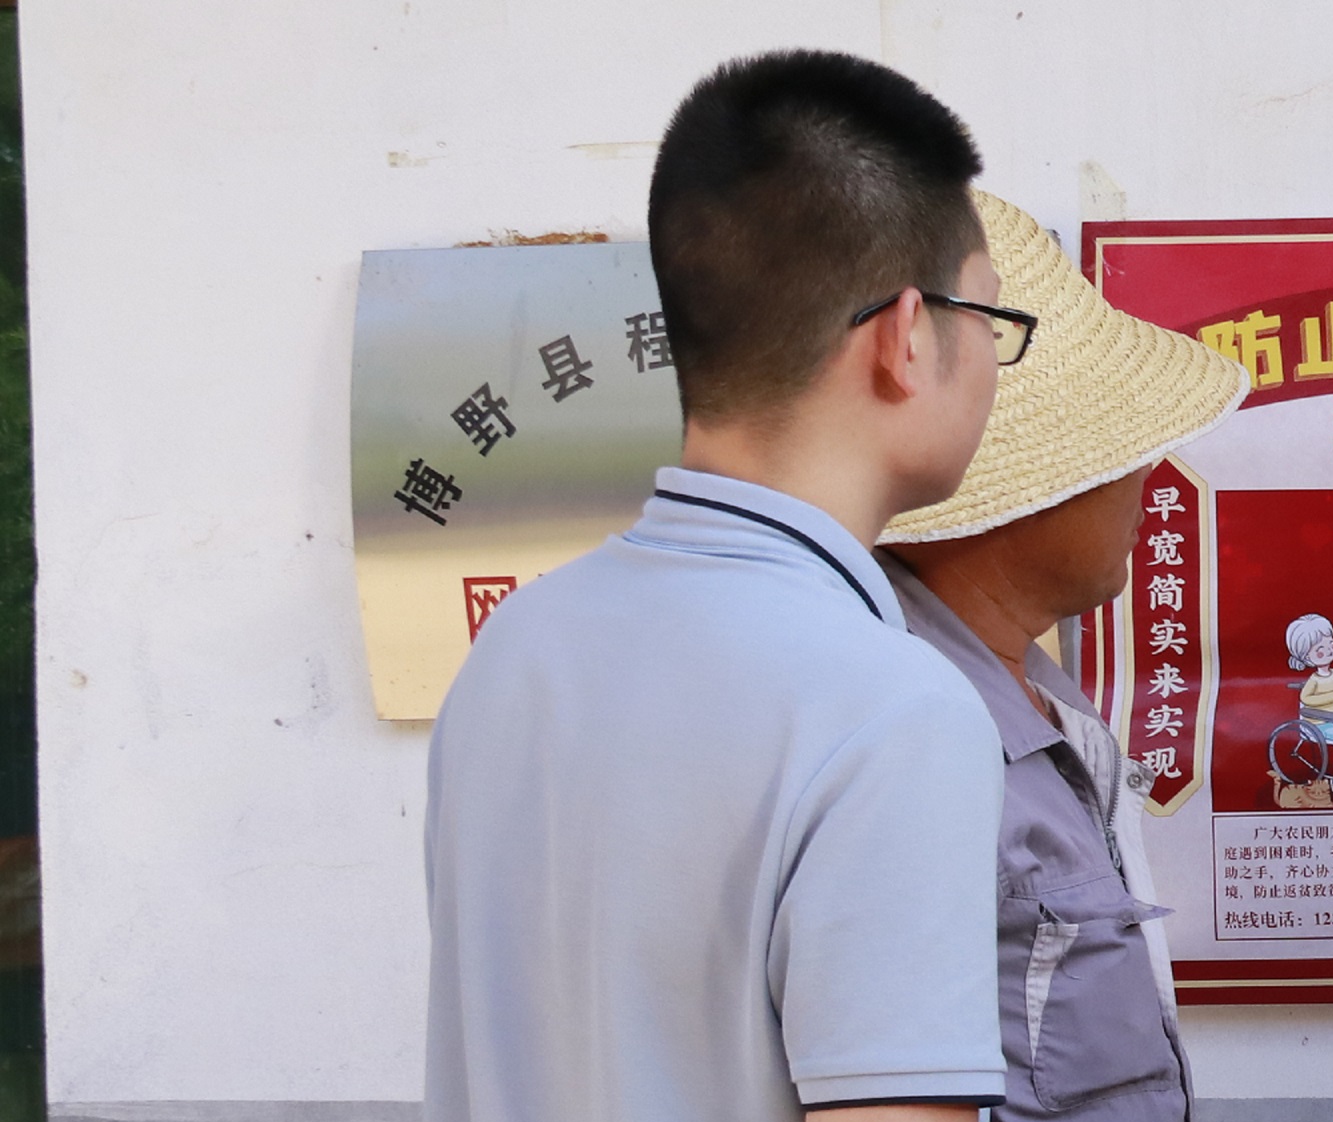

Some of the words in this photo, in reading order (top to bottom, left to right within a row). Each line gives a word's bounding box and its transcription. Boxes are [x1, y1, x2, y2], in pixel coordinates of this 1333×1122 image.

[394, 311, 676, 527] 博野县程
[1142, 486, 1188, 781] 早宽简实来实现
